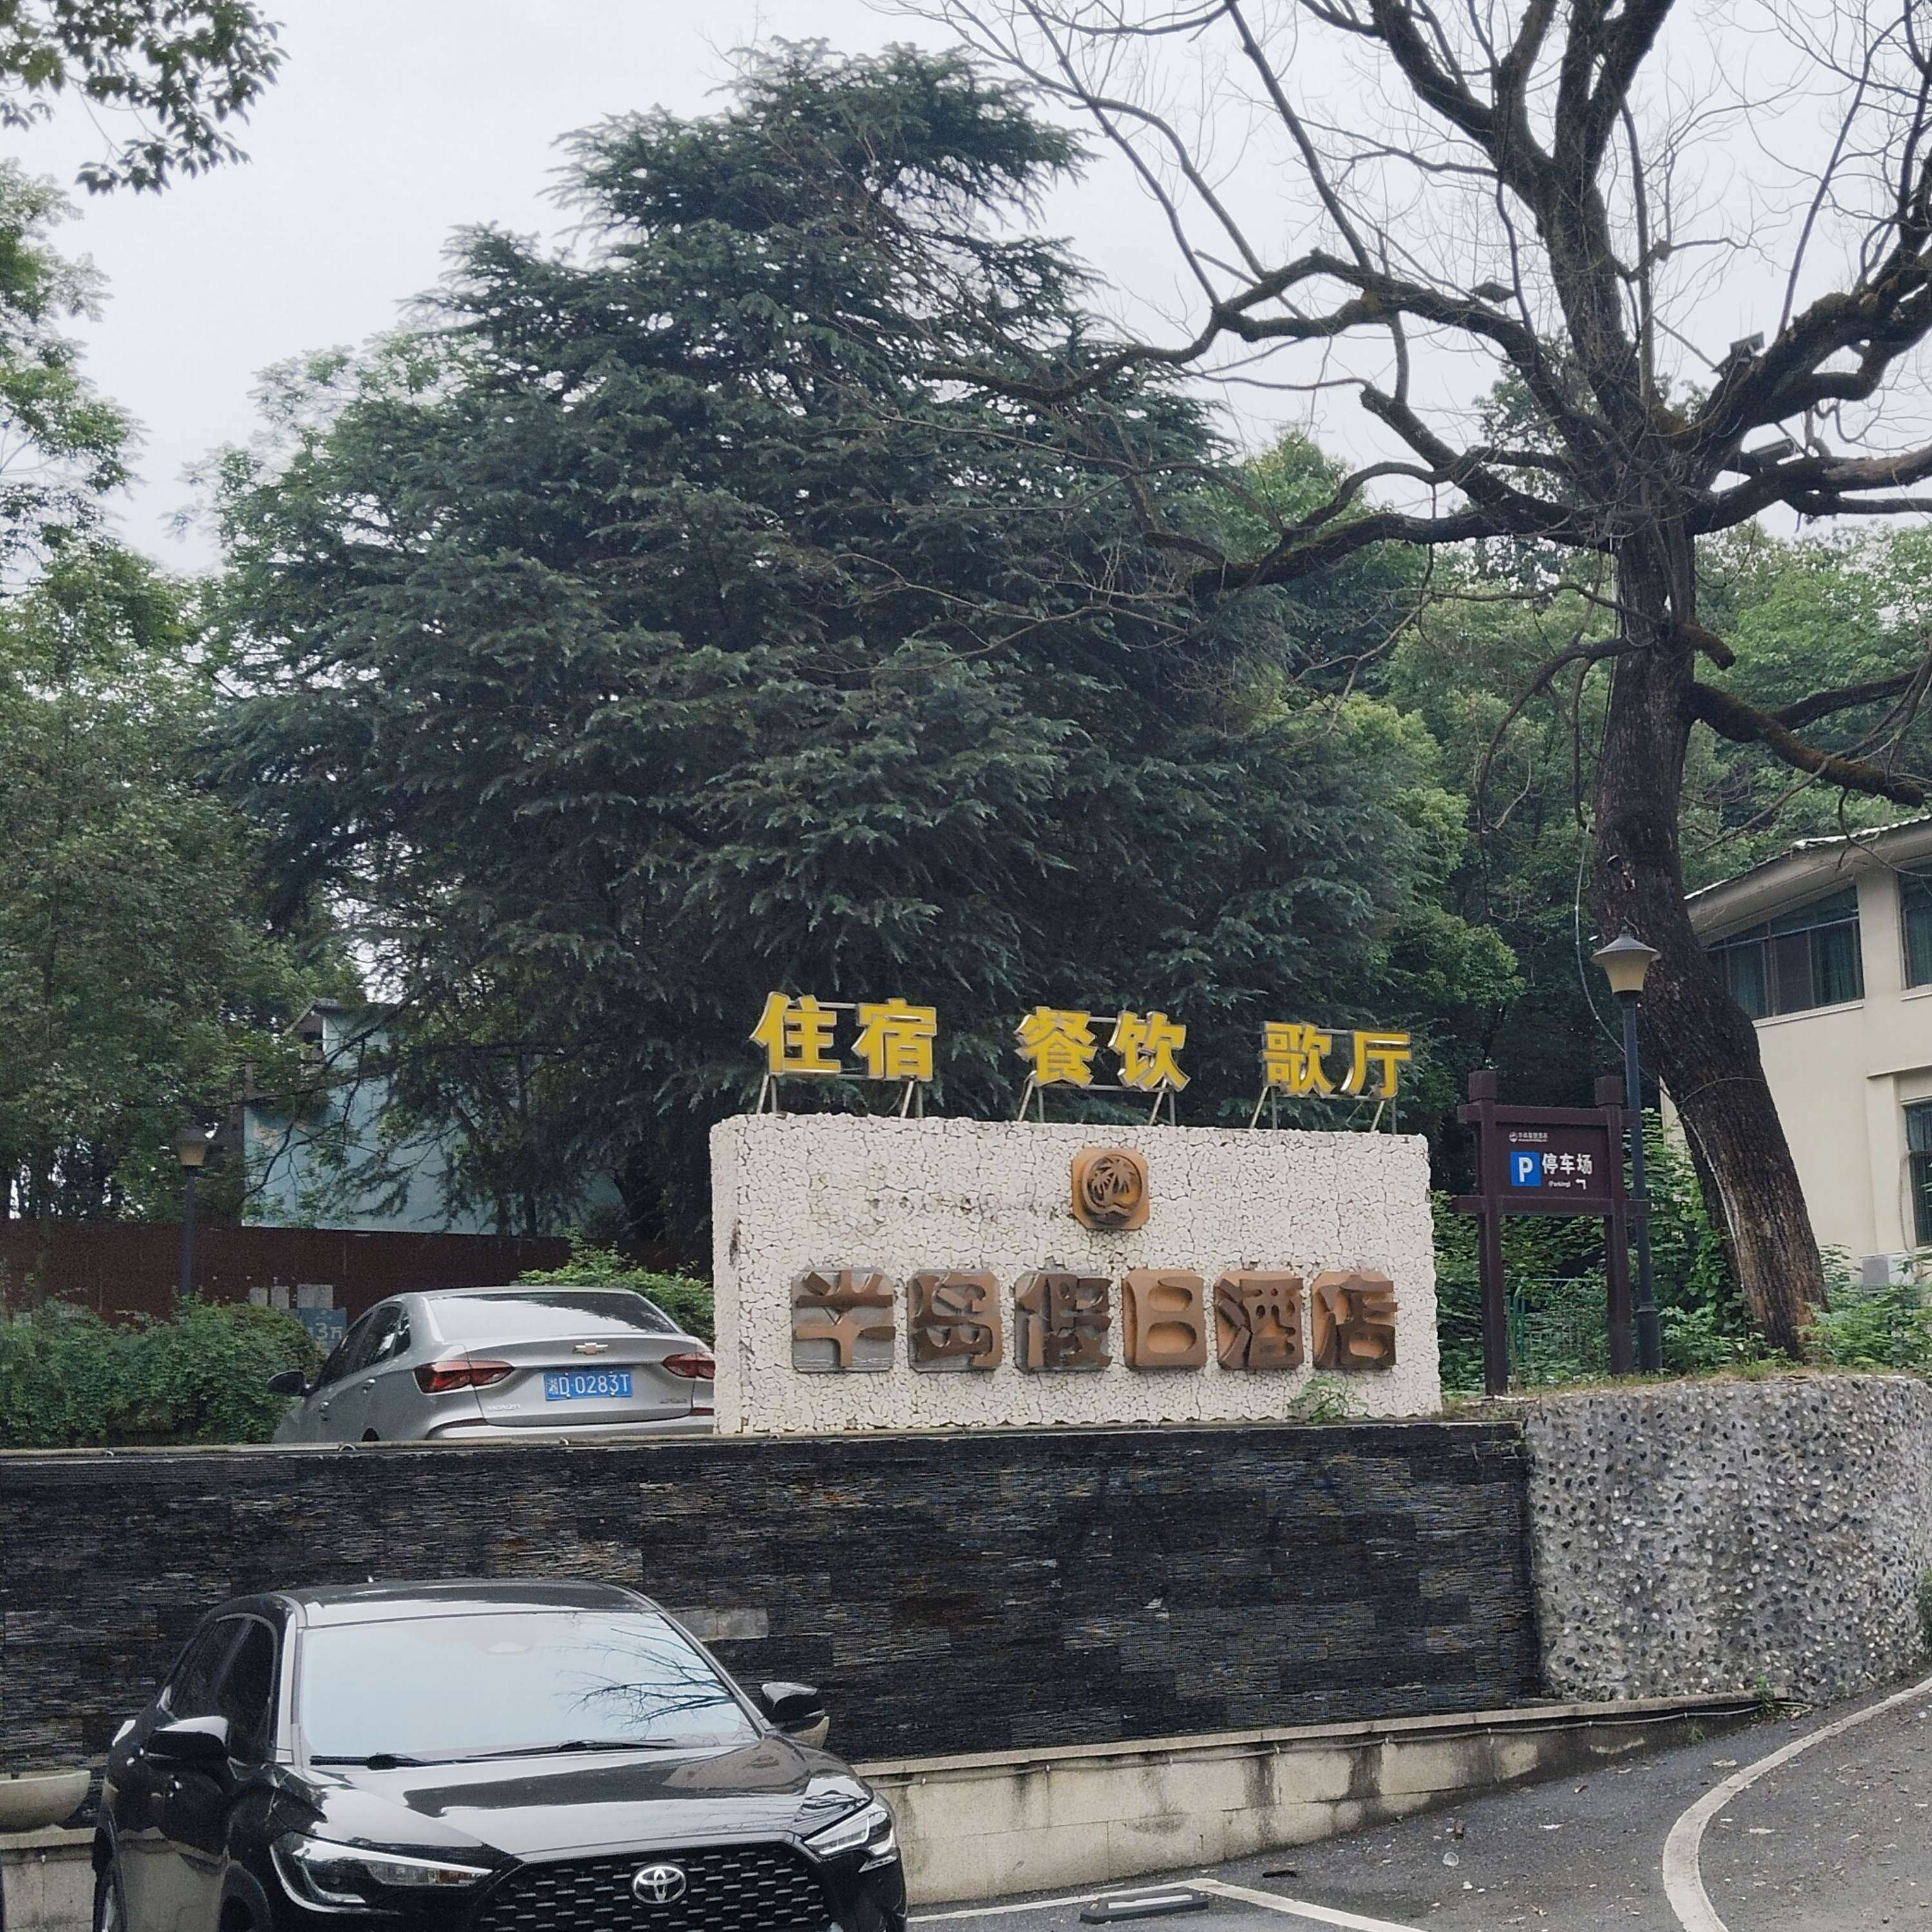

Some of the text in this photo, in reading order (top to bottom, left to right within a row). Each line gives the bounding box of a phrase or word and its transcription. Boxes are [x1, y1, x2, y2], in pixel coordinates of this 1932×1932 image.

[752, 991, 1412, 1099] 住宿 餐饮 歌厅
[1519, 1157, 1533, 1182] P
[1542, 1153, 1592, 1175] 停车场
[795, 1270, 1397, 1368] 半岛假日酒店
